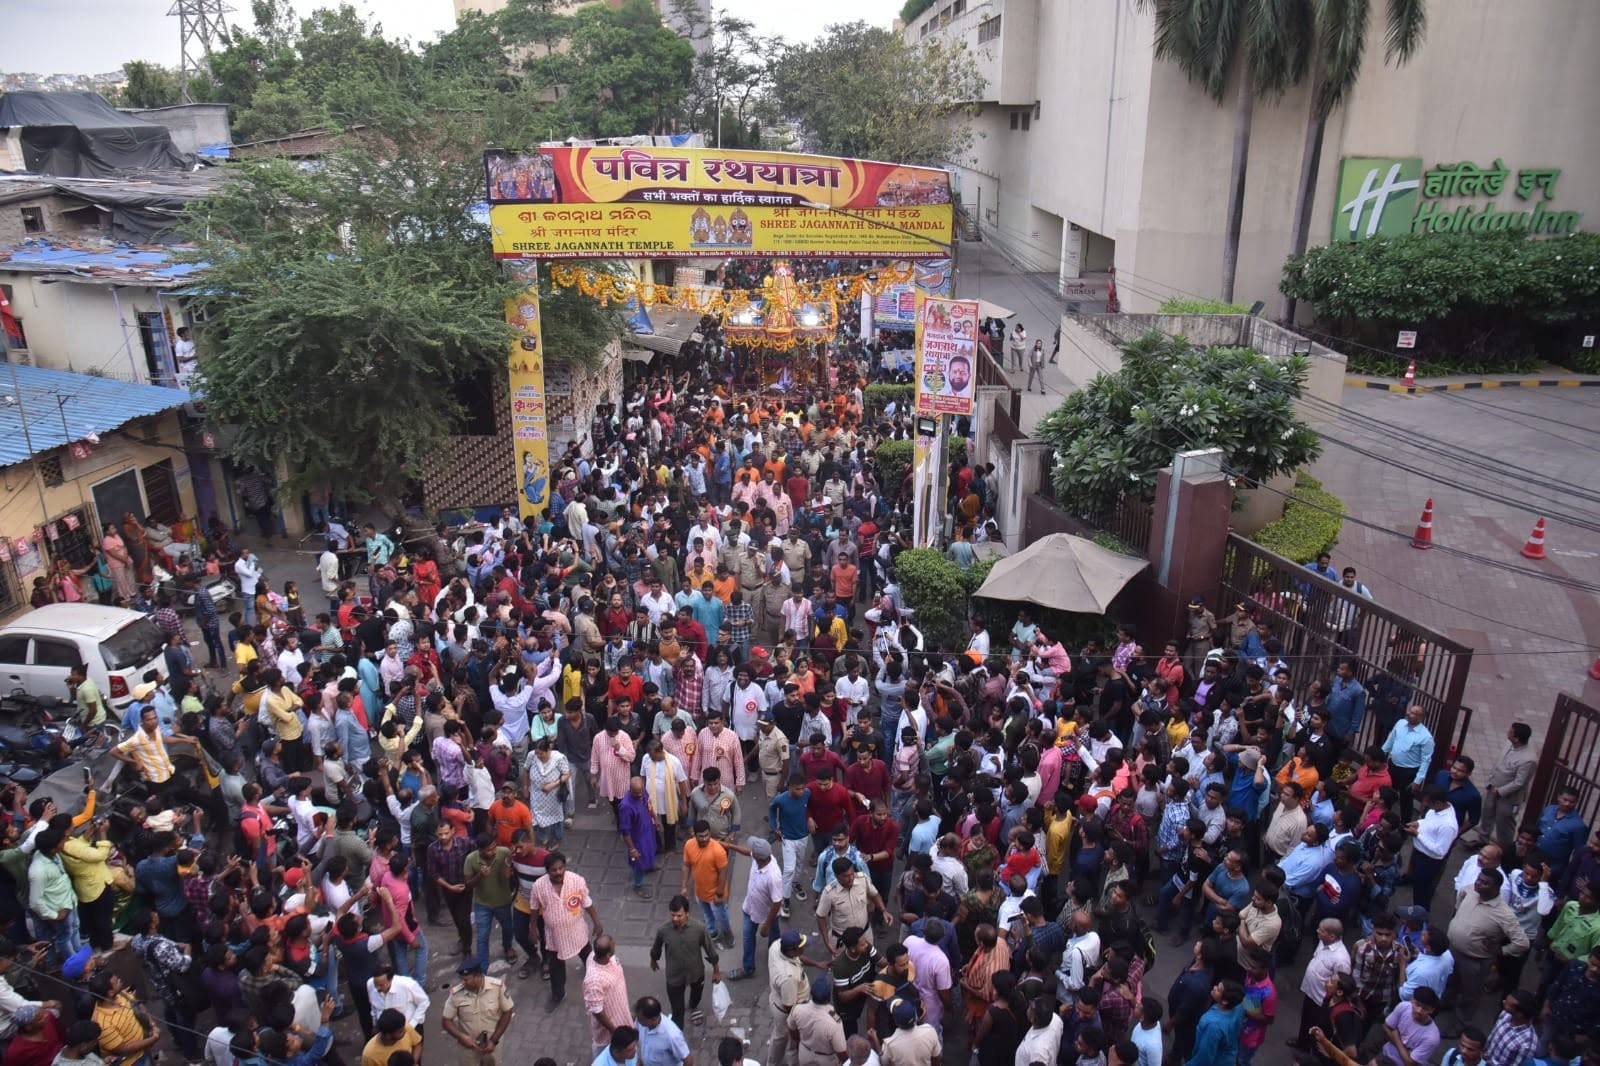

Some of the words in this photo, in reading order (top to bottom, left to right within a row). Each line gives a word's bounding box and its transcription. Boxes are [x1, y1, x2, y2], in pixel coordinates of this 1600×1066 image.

[592, 149, 690, 182] पवित्र
[702, 158, 842, 188] रथयात्रा
[1424, 158, 1508, 199] हॉलिडे
[643, 190, 666, 202] सभी
[670, 190, 700, 202] भक्तों
[704, 192, 717, 202] का
[721, 192, 755, 204] हार्दिक
[758, 194, 793, 205] स्वागत
[1411, 200, 1530, 233] Holiday
[1529, 200, 1581, 234] Inn
[531, 226, 546, 238] श्री
[551, 227, 602, 238] जगन्नाथ
[605, 225, 639, 237] मंदिर
[760, 220, 797, 229] SHREE
[800, 220, 865, 230] JAGANNATH
[899, 221, 945, 231] MANDAL
[512, 242, 551, 251] SHREE
[554, 241, 624, 251] JAGANNATH
[627, 240, 675, 250] TEMPLE
